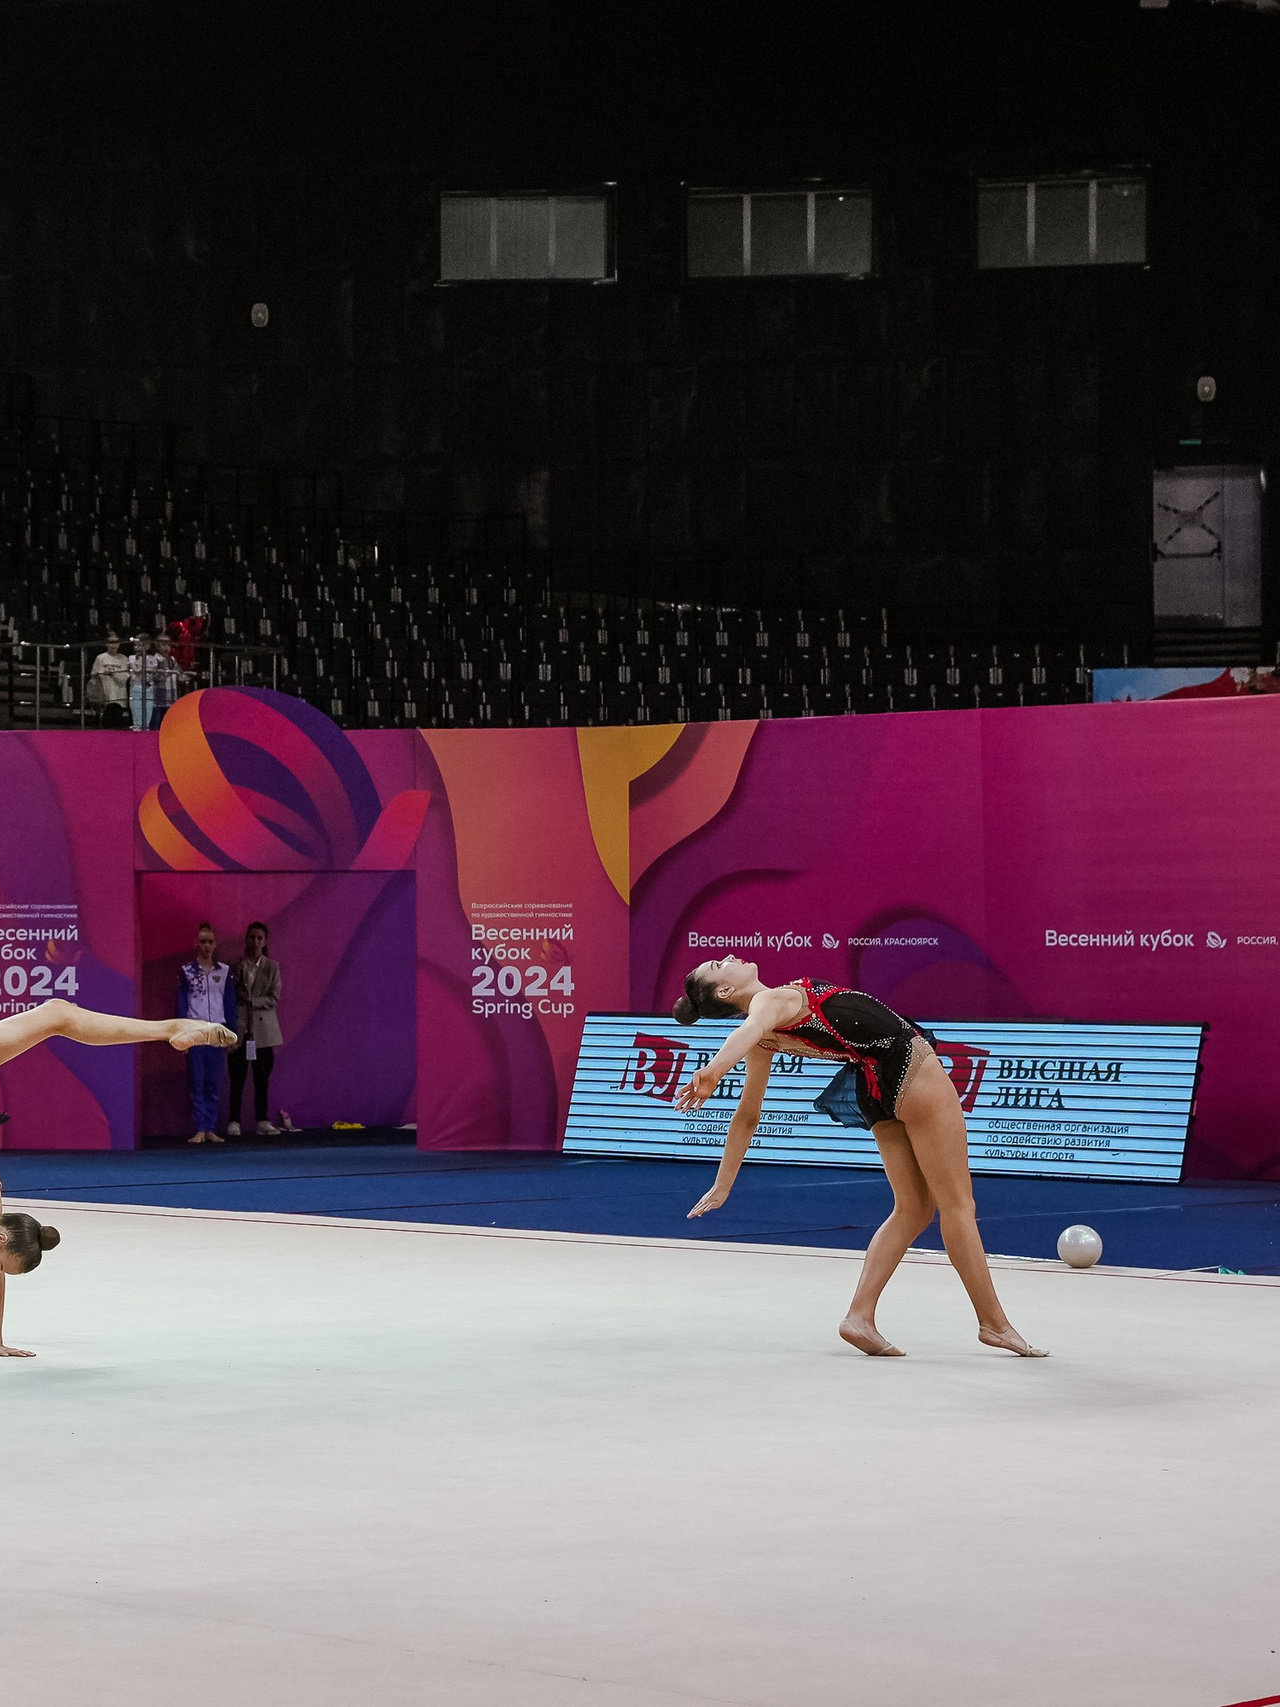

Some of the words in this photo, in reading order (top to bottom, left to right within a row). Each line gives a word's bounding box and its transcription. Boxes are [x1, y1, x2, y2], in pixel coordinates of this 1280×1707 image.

[471, 923, 574, 941] Весенний
[688, 931, 763, 948] Весенний
[767, 931, 812, 951] кубок
[884, 937, 939, 946] КРАСНОЯРСК
[1045, 929, 1134, 947] Весенний
[1140, 929, 1194, 951] кубок
[471, 943, 531, 965] кубок
[471, 965, 575, 997] 2024
[472, 999, 533, 1019] Spring
[538, 999, 575, 1018] Cup
[996, 1058, 1124, 1082] ВЫСШАЯ
[991, 1086, 1066, 1109] ЛИГА
[988, 1119, 1061, 1132] общественная
[1064, 1122, 1130, 1135] организация
[1001, 1134, 1062, 1146] содействию
[1064, 1136, 1111, 1149] развития
